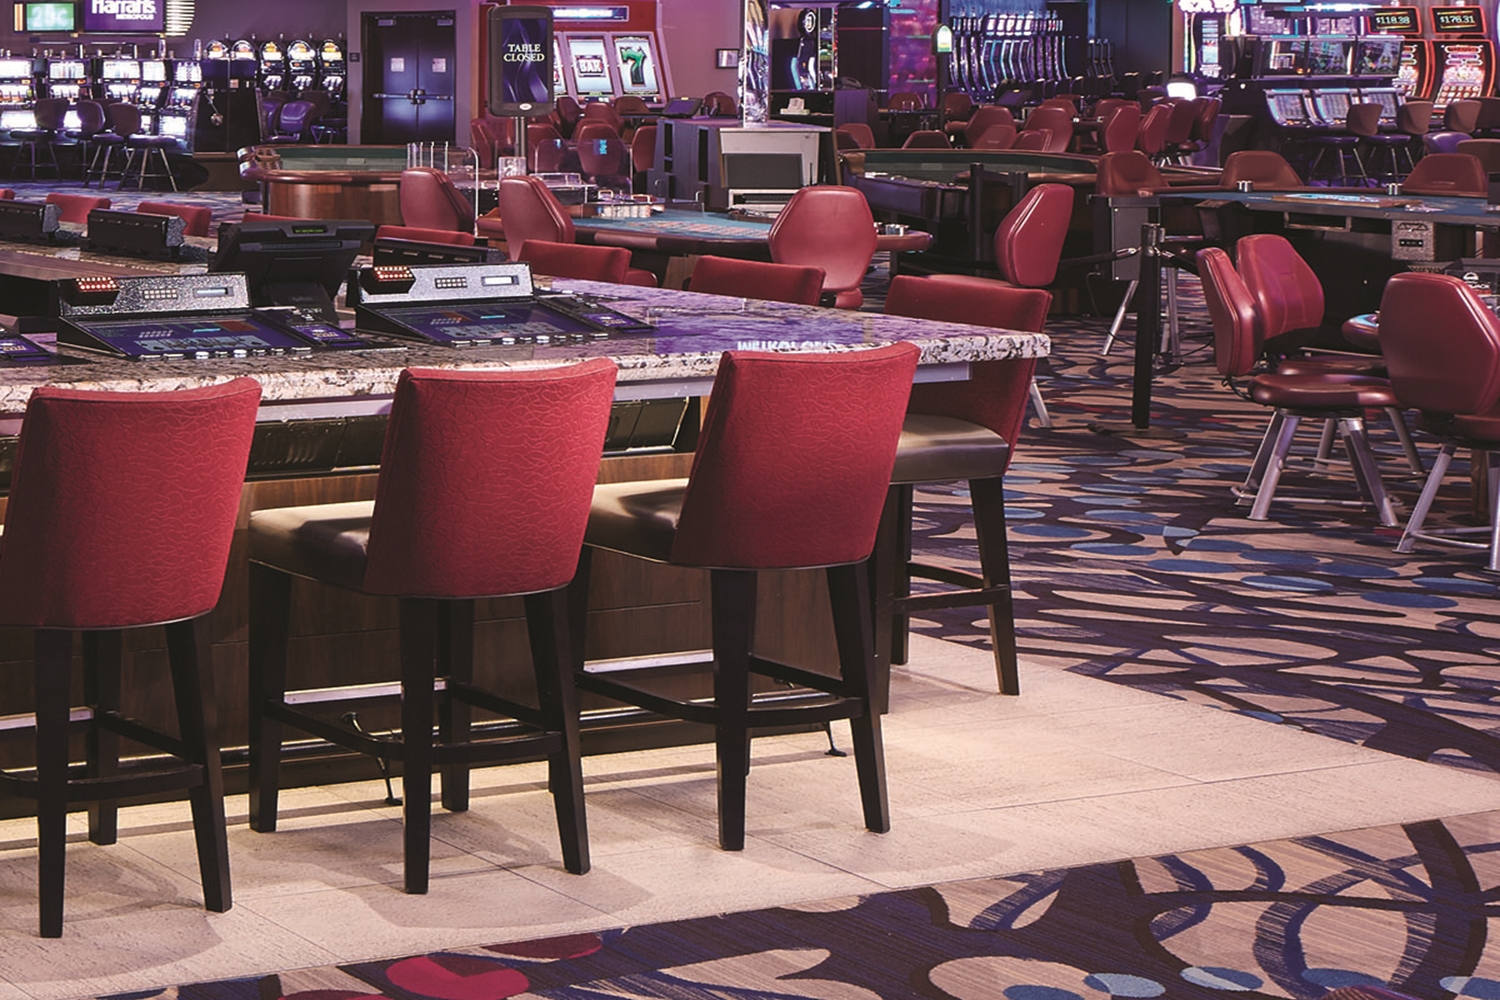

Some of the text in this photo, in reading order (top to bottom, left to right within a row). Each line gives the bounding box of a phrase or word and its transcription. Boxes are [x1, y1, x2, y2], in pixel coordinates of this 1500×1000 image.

[507, 43, 541, 53] TABLE
[503, 52, 545, 63] CLOSED
[579, 59, 603, 73] BAR
[620, 46, 647, 86] 7
